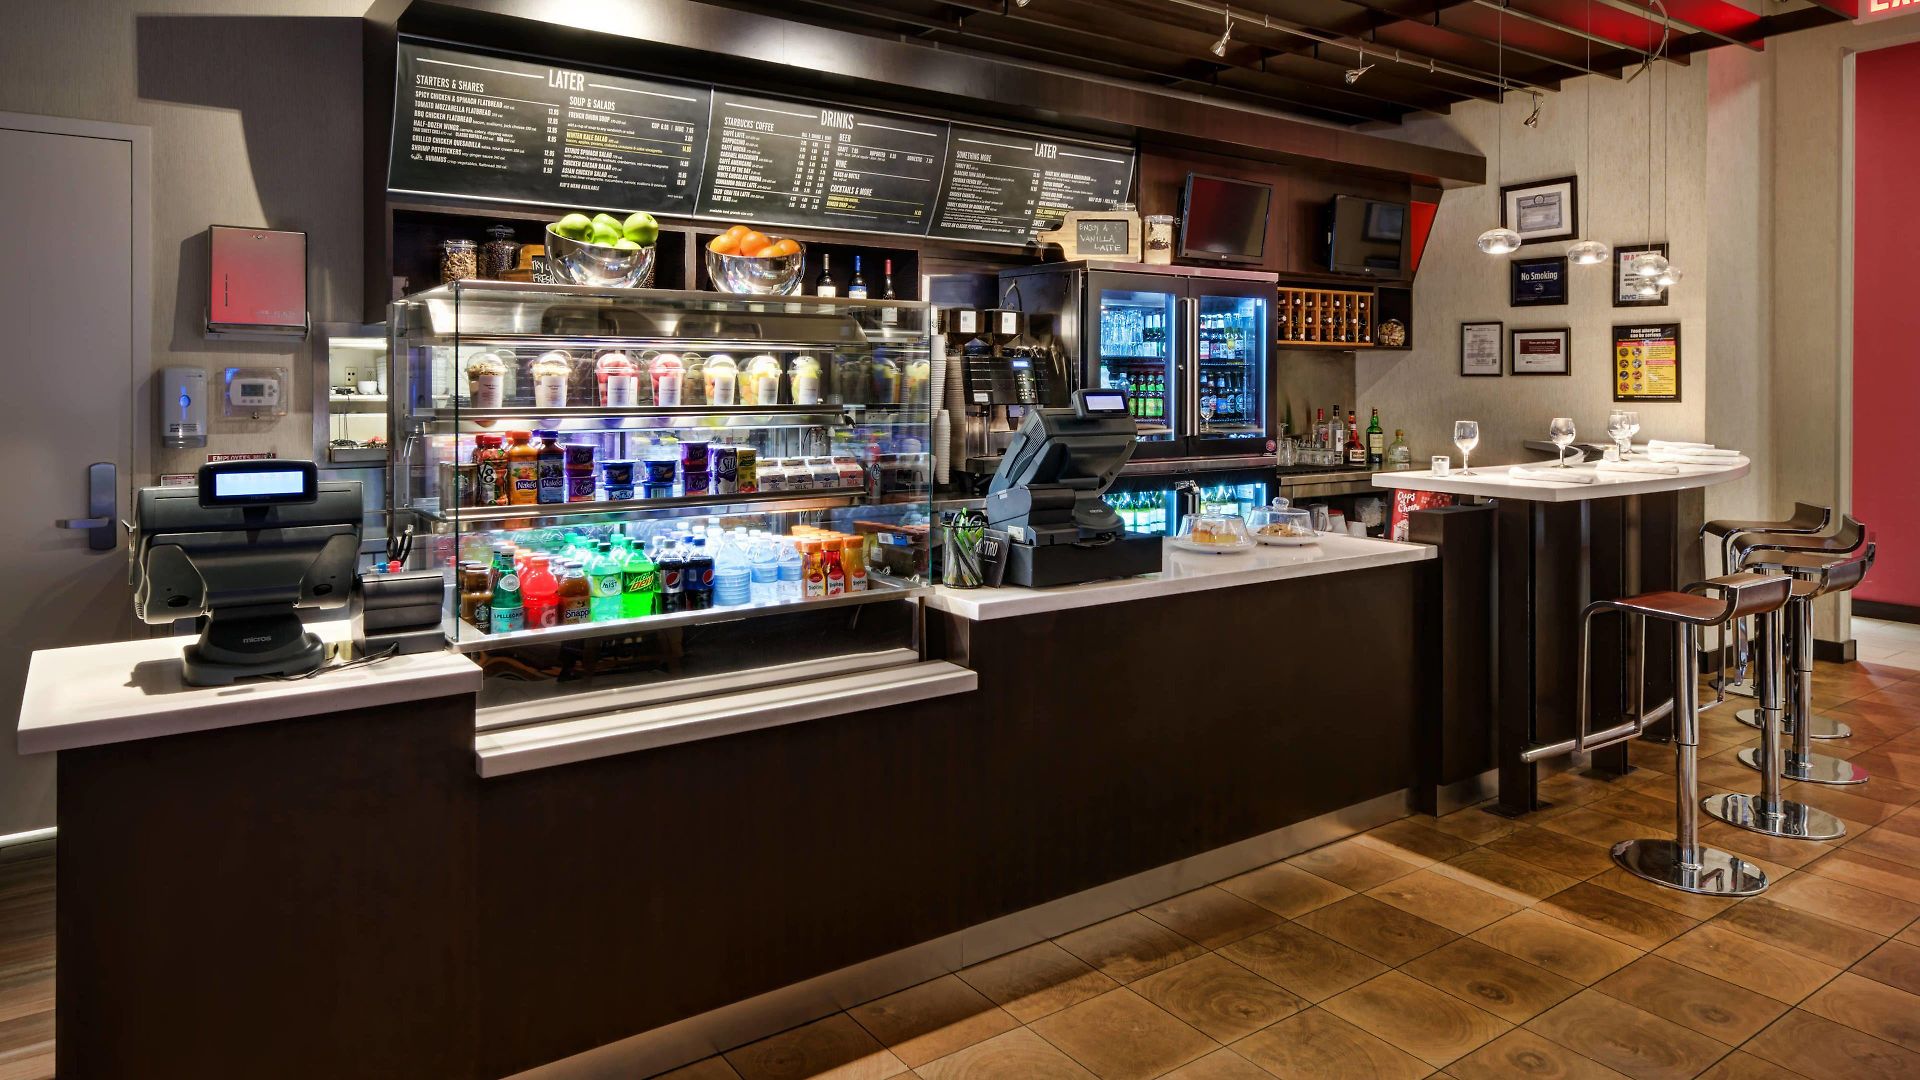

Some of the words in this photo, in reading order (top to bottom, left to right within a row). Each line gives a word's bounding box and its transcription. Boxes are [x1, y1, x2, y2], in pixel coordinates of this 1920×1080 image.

[416, 75, 449, 88] STARTERS
[452, 80, 456, 88] &
[458, 82, 484, 93] SHARES
[549, 69, 584, 92] LATER
[415, 91, 429, 99] SPICY
[431, 93, 451, 102] CHICKEN
[569, 96, 585, 106] SOUP
[587, 99, 591, 107] &
[593, 101, 615, 111] SALADS
[425, 111, 446, 120] CHICKEN
[821, 111, 854, 130] DRINKS
[414, 120, 442, 129] HALF-DOZEN
[444, 123, 459, 131] WINGS
[724, 117, 753, 128] STARBUCKS
[756, 121, 774, 132] COFFEE
[432, 137, 453, 146] CHICKEN
[839, 133, 851, 142] BEER
[957, 150, 980, 161] SOMETHING
[980, 154, 992, 162] MORE
[1035, 143, 1057, 159] LATER
[836, 159, 848, 168] WINE
[830, 184, 854, 194] COCKTAILS
[855, 187, 859, 195] &
[860, 188, 872, 196] MORE
[1080, 234, 1115, 243] VANILLA
[532, 259, 543, 273] TRY
[1521, 272, 1530, 281] No
[1531, 271, 1558, 281] Smoking
[517, 481, 537, 489] Naked
[1398, 491, 1415, 503] Cups
[565, 609, 591, 619] Snapp
[243, 635, 271, 644] micros
